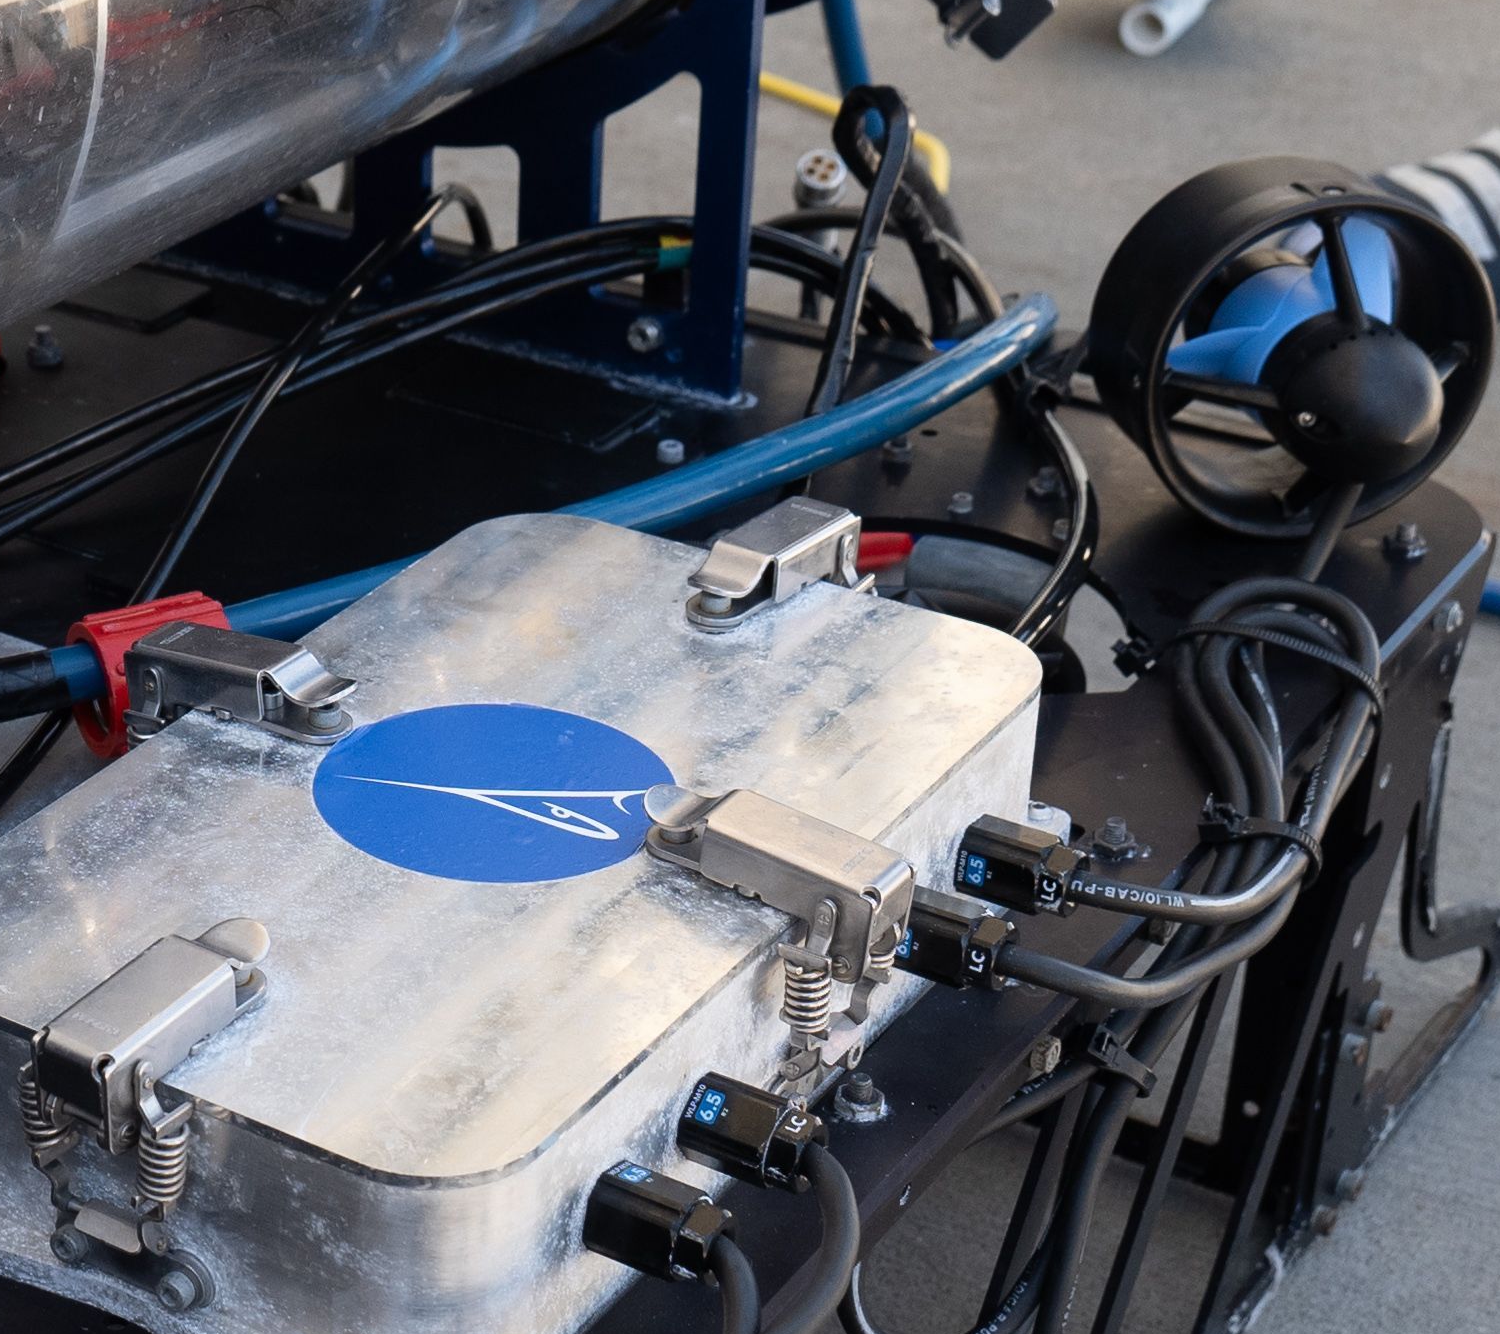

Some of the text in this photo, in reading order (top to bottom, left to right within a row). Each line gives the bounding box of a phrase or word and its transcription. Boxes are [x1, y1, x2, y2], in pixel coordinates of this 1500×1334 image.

[966, 858, 985, 884] 6.5
[1040, 879, 1058, 902] LC
[968, 949, 986, 974] LC
[700, 1092, 722, 1122] 6.5
[784, 1115, 808, 1134] LC
